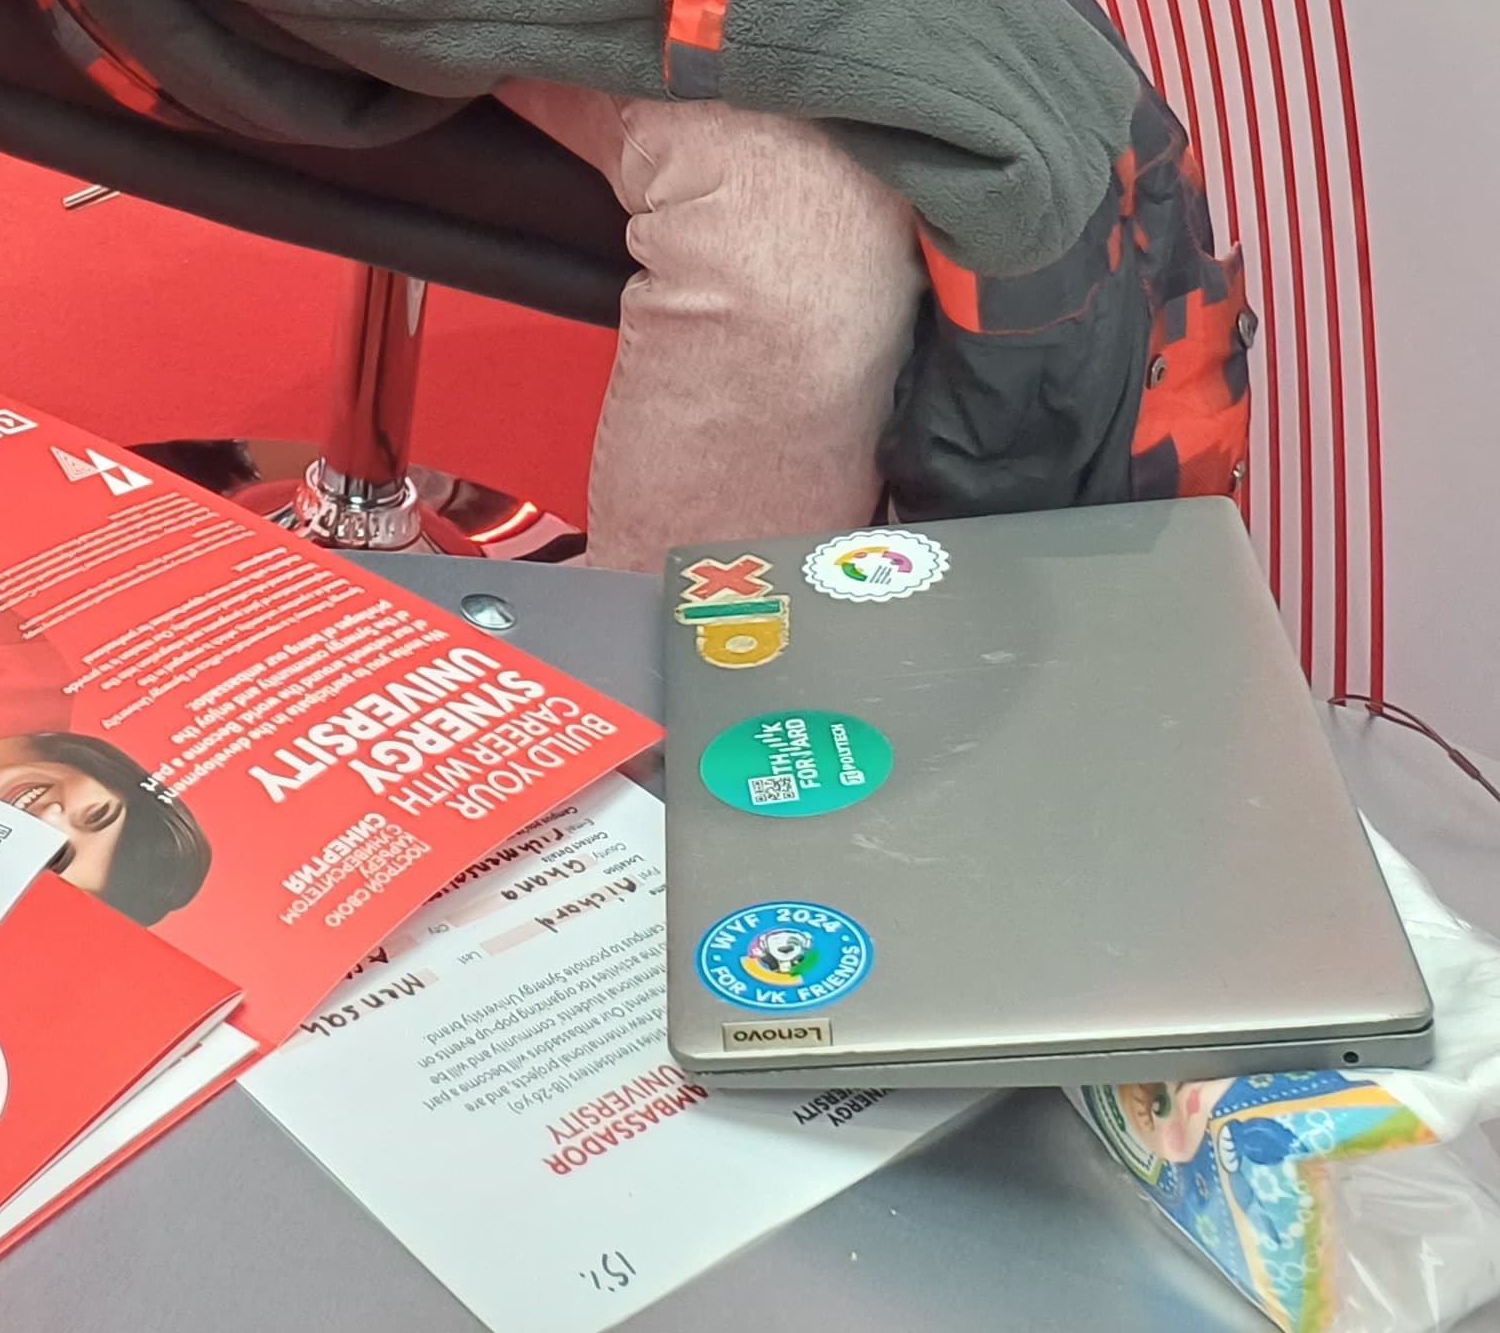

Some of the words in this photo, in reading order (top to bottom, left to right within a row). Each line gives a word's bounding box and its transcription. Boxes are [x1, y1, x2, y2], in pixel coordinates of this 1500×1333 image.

[245, 646, 502, 805] UNIVERSITY
[345, 666, 546, 796] SYNERGY
[460, 693, 581, 767] CAREER
[525, 711, 618, 770] BUILD
[830, 723, 855, 769] POLYTECH
[385, 755, 483, 818] WITH
[443, 756, 542, 823] YOUR
[280, 811, 387, 896] СИНЕРГИЯ
[358, 831, 416, 879] КАРЬЕРУ
[363, 838, 431, 894] ПОСТРОЙ
[499, 852, 587, 909] Ghana
[321, 889, 371, 929] СВОЮ
[710, 914, 760, 950] WYF
[777, 909, 842, 933] 2024
[711, 966, 748, 994] FOR
[756, 989, 786, 1004] VK
[797, 945, 861, 1002] FRIENDS
[598, 1004, 626, 1024] Our
[732, 1026, 821, 1045] Lenovo
[462, 1097, 486, 1113] are
[483, 1085, 512, 1106] and
[545, 1065, 684, 1145] UNIVERSITY
[541, 1082, 710, 1177] AMBASSADOR
